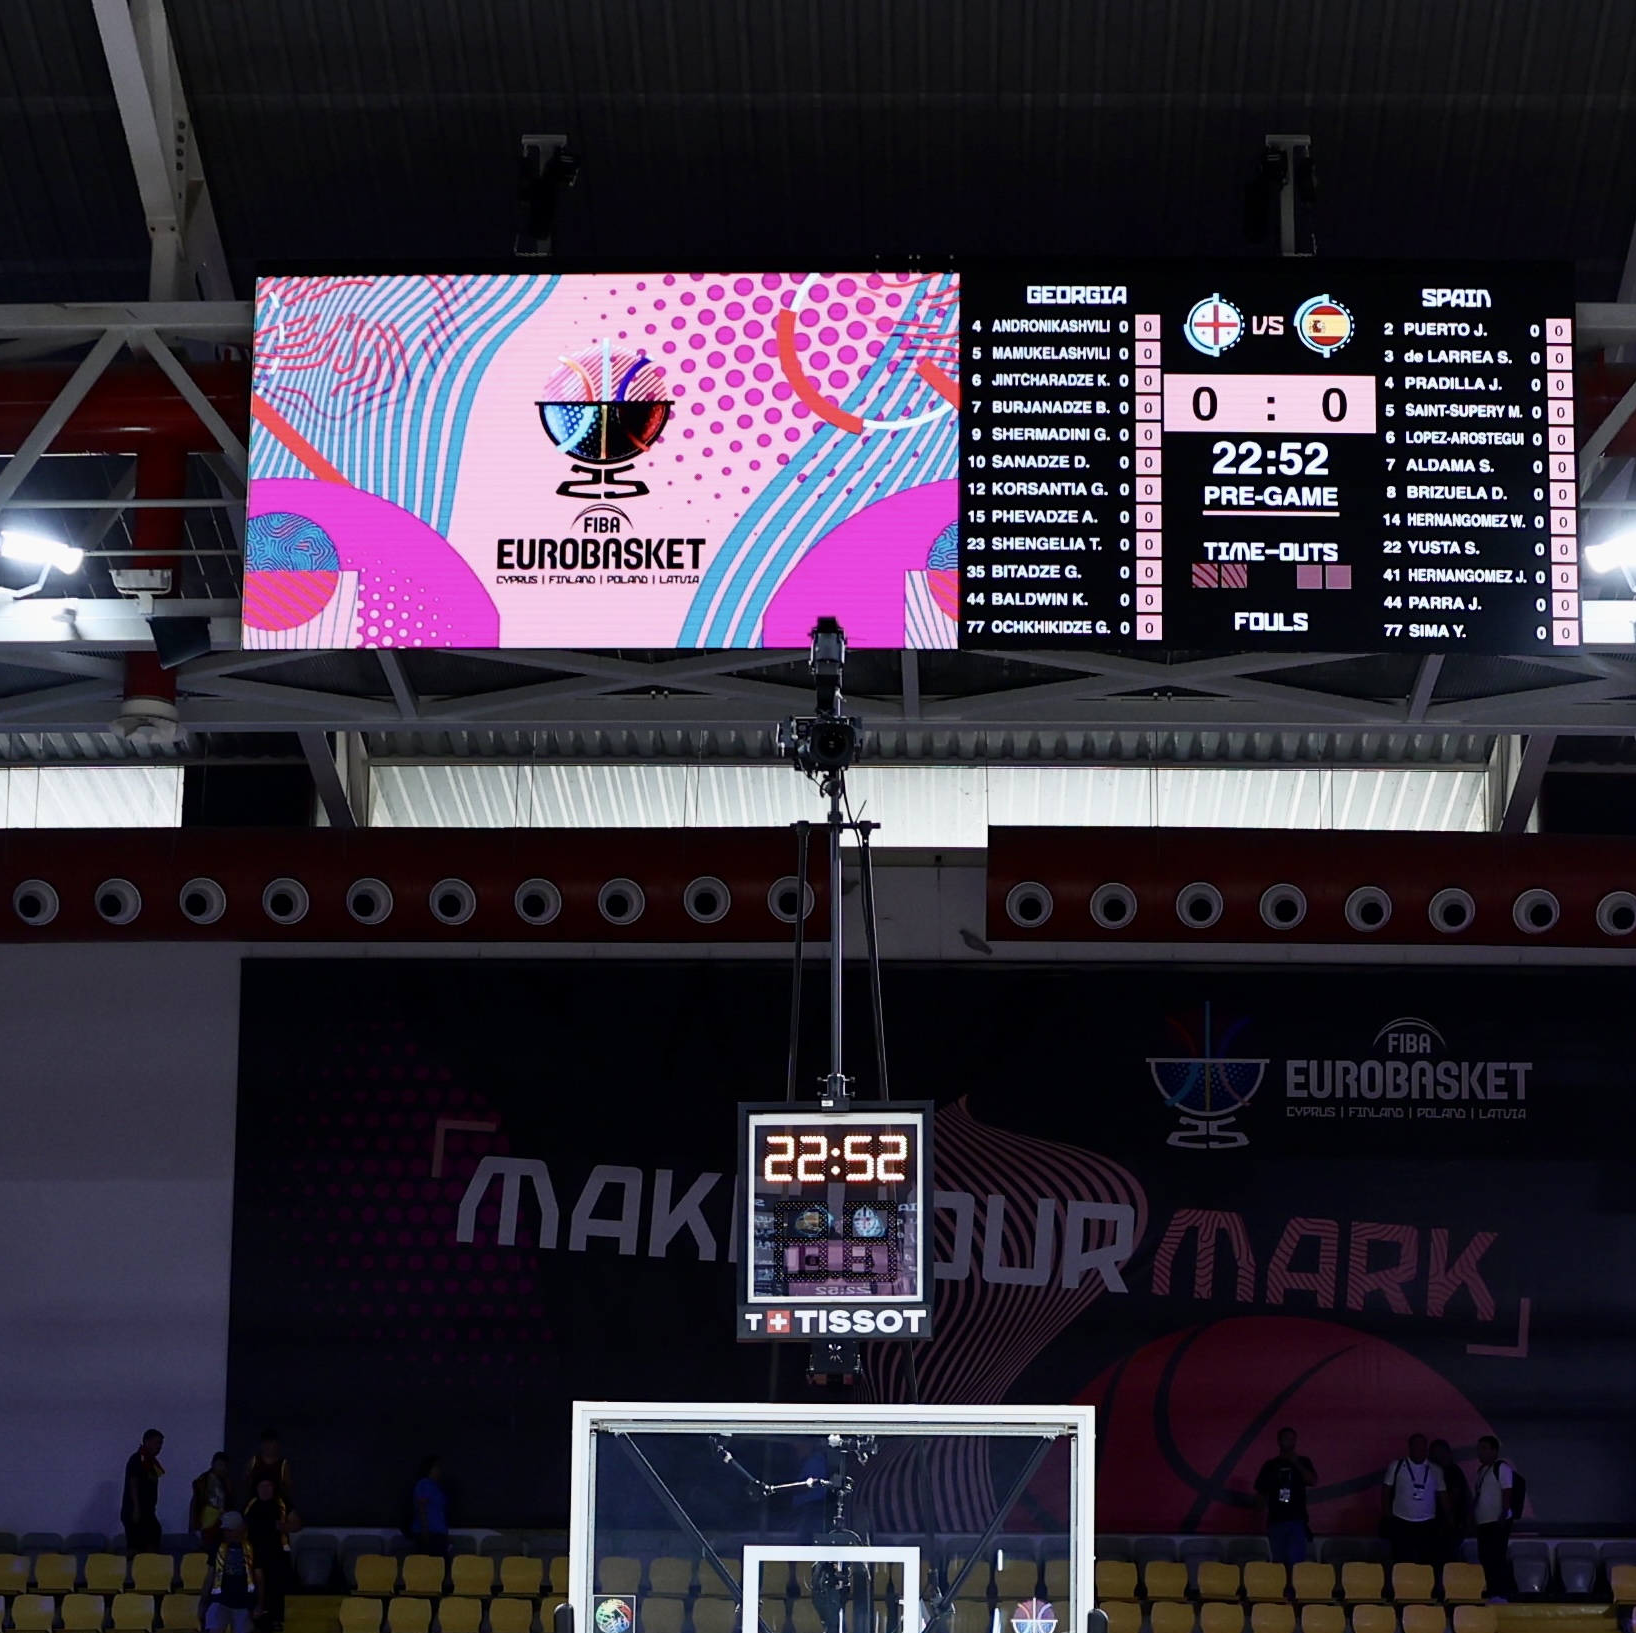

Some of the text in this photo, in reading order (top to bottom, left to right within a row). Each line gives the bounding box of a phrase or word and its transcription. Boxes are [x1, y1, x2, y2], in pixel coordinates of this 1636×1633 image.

[1027, 286, 1126, 304] GEORGIA
[1422, 289, 1491, 307] SPAIN
[971, 318, 1153, 334] 4 ANDRONIKASHVILI 0 0
[1253, 316, 1283, 335] VS
[1383, 322, 1540, 338] 2 PUERTO J. 0
[972, 346, 1153, 361] 5 MAMUKELASHVILI 0 0
[1384, 349, 1541, 365] 3 de LARREA S. 0
[971, 372, 1153, 388] 6 JINTCHARADZE K. 0 0
[1384, 376, 1541, 392] 4 PRADILLA J. 0
[971, 400, 1153, 415] 7 BURJANADZE B. 0 0
[1192, 386, 1348, 423] 0 0
[1385, 402, 1542, 420] 5 SAINT-SUPERY M. 0
[971, 426, 1153, 442] 9 SHERMADINI G. 0 0
[1385, 430, 1543, 447] 6 LOPEZ-AROSTEGUI 0
[967, 454, 1154, 470] 10 SANADZE D. 0 0
[1212, 440, 1329, 476] 22:52
[1385, 458, 1543, 474] 7 ALDAMA S. 0
[967, 481, 1154, 496] 12 KORSANTIA G. 0 0
[1204, 485, 1339, 507] PRE-GAME
[1386, 485, 1544, 501] 8 BRIZUELA D. 0
[583, 516, 621, 534] FIBA
[967, 509, 1154, 524] 15 PHEVADZE A. 0 0
[1382, 512, 1545, 529] 14 HERNANGOMEZ W. 0
[966, 536, 1154, 552] 23 SHENGELIA T. 0 0
[1203, 541, 1339, 562] TIME-OUTS
[1382, 540, 1545, 557] 22 YUSTA S. 0
[496, 537, 706, 571] EUROBASKET
[496, 575, 700, 585] CYPRUS FINLAND POLAND LATVIA
[966, 564, 1154, 579] 35 BITADZE G. 0 0
[1382, 568, 1546, 584] 41 HERNANGOMEZ J. 0
[966, 592, 1154, 607] 44 BALDWIN K. 0 0
[1383, 595, 1546, 612] 44 PARRA J. 0
[966, 619, 1154, 635] 77 OCHKHIKIDZE G. 0 0
[1234, 611, 1309, 632] FOULS
[1383, 623, 1546, 640] 77 SIMA Y. 0
[1388, 1033, 1431, 1054] FIBA
[1286, 1059, 1533, 1100] EUROBASKET
[1286, 1106, 1526, 1119] CYPRUS FINLAND POLAND LATVIA
[765, 1135, 907, 1182] 22:52
[1152, 1207, 1498, 1321] MARK
[794, 1309, 927, 1333] TISSOT
